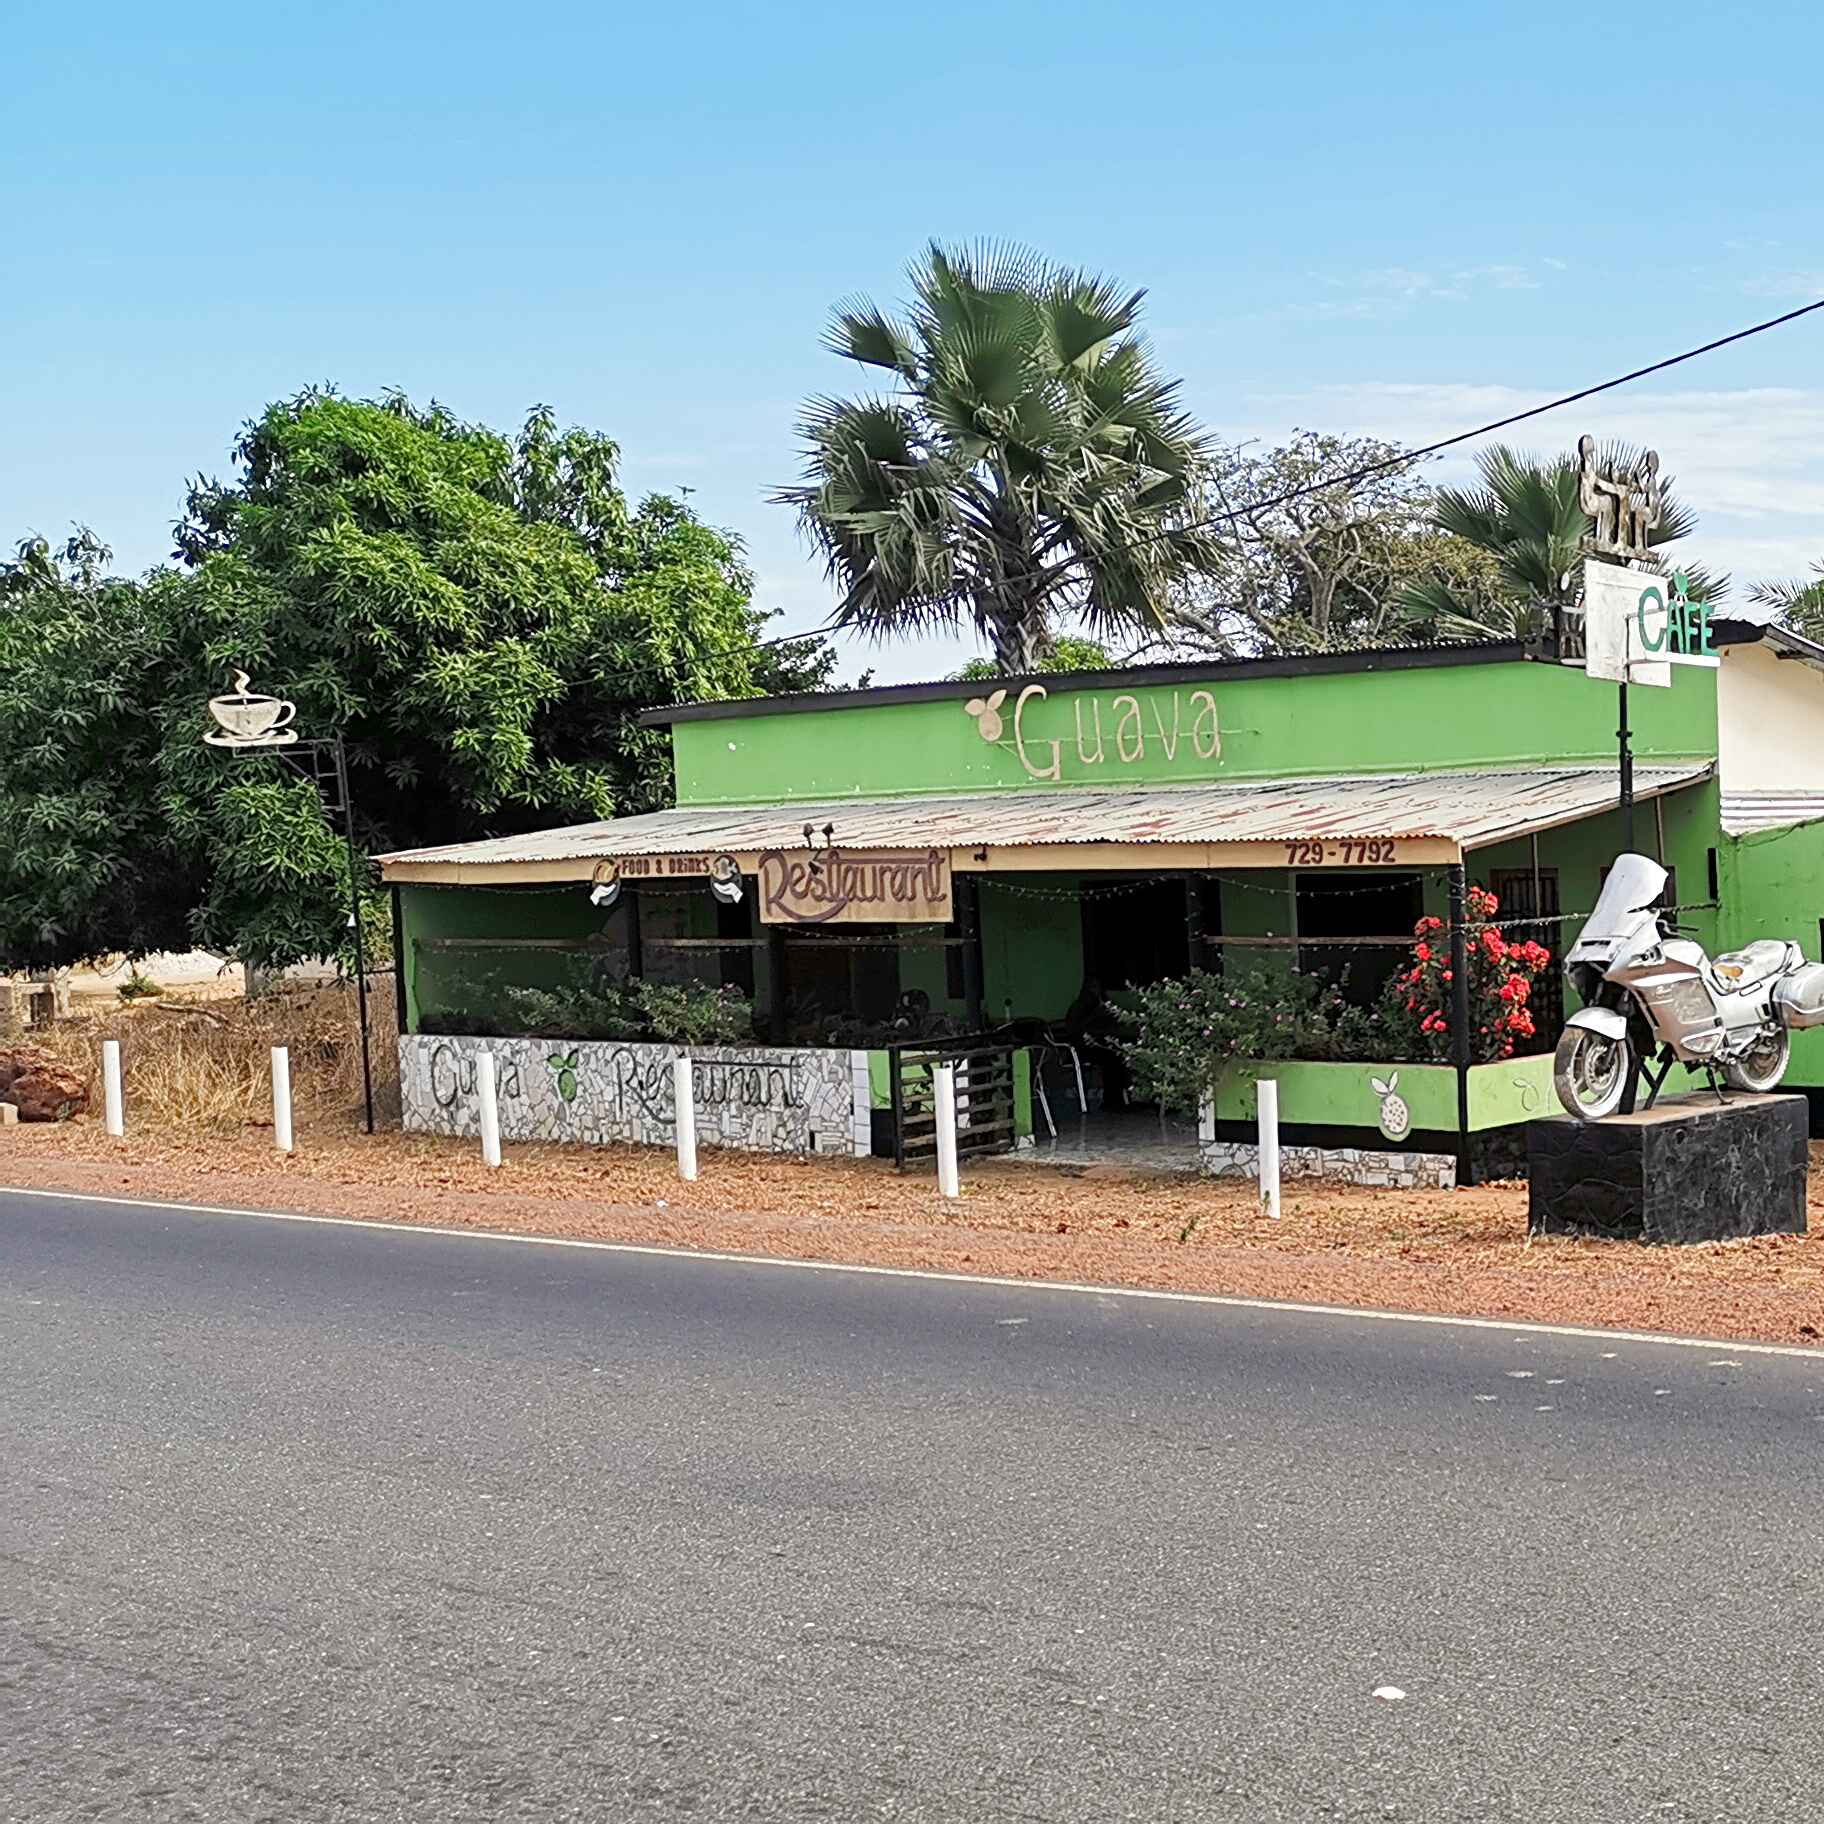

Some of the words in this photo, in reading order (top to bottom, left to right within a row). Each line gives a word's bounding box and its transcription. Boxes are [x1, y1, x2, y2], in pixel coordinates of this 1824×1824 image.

[1014, 684, 1221, 780] Guava
[621, 858, 650, 875] FOOD
[655, 859, 664, 874] &
[759, 850, 947, 922] Restaurant
[1285, 840, 1396, 864] 729-7792
[431, 1044, 521, 1108] Gua
[611, 1047, 804, 1124] Resaurant
